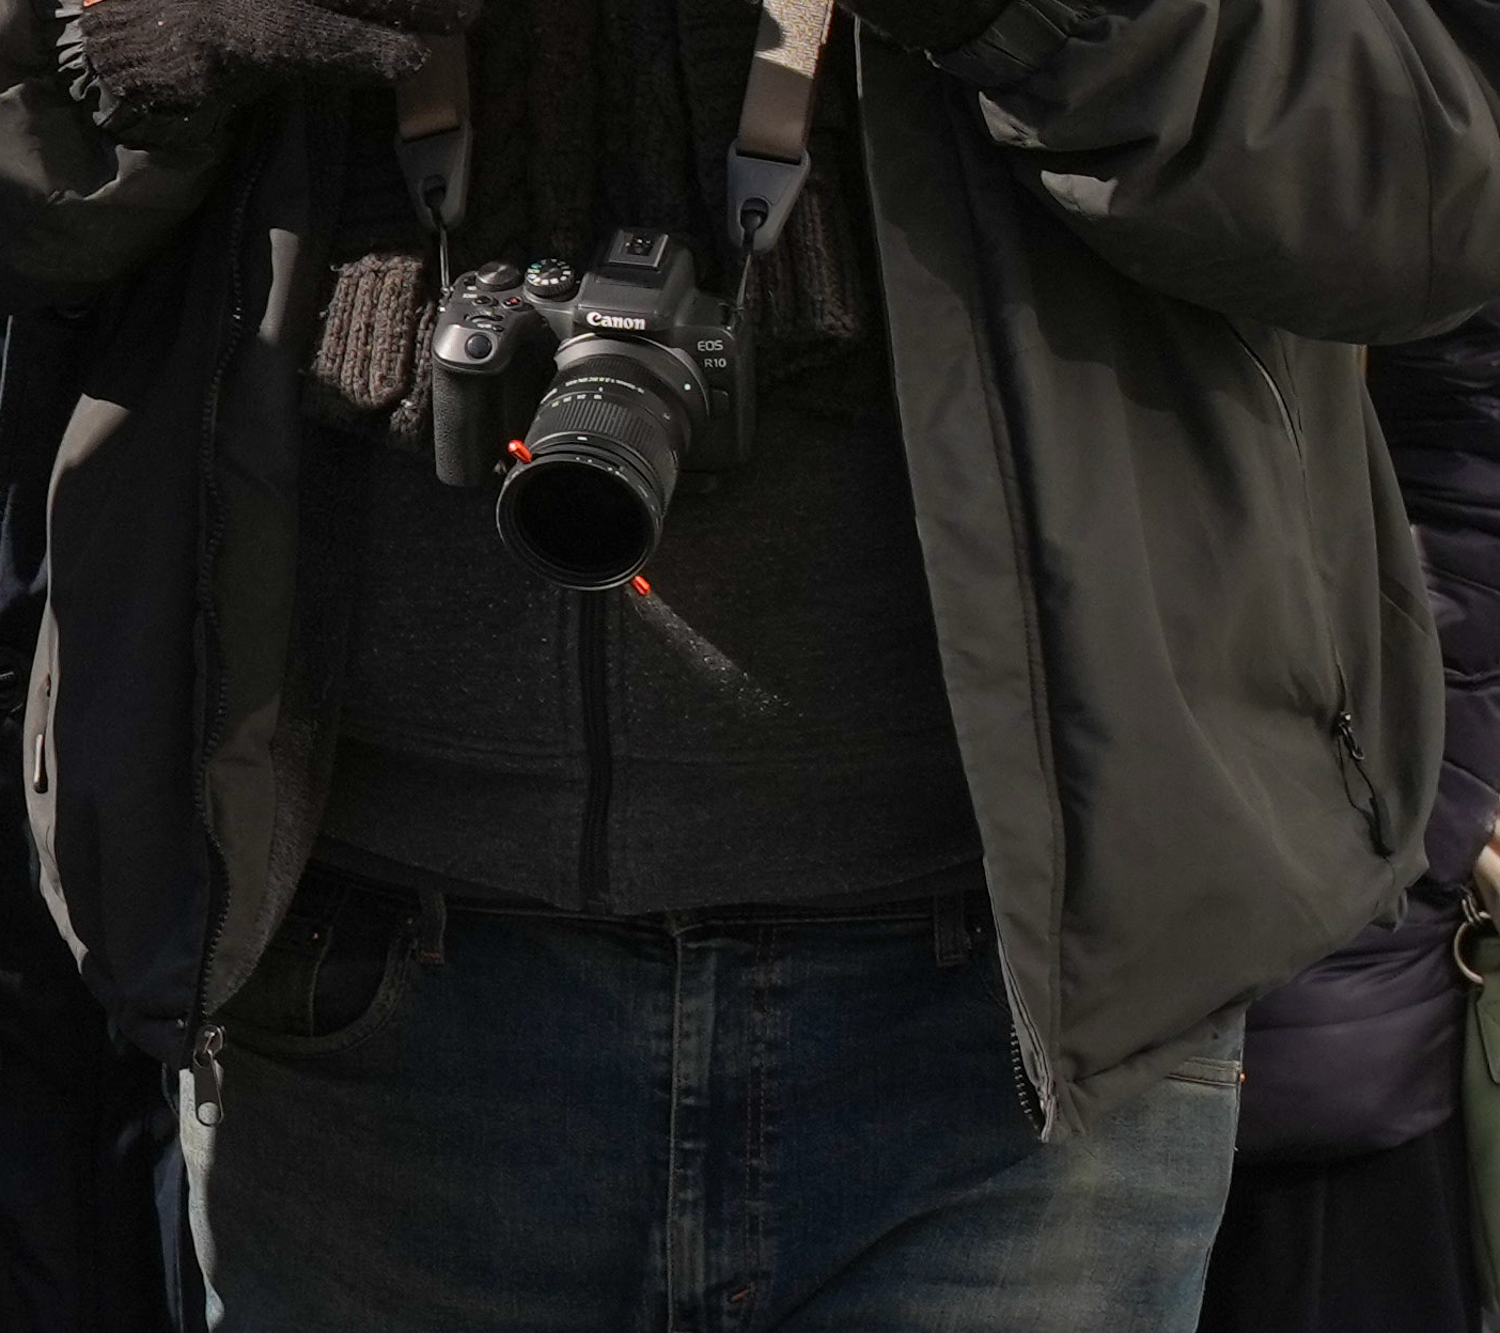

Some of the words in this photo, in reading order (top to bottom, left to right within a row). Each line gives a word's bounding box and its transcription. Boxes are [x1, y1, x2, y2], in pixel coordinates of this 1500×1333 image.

[586, 311, 646, 331] Canon
[697, 339, 724, 352] EOS
[704, 357, 727, 369] R10
